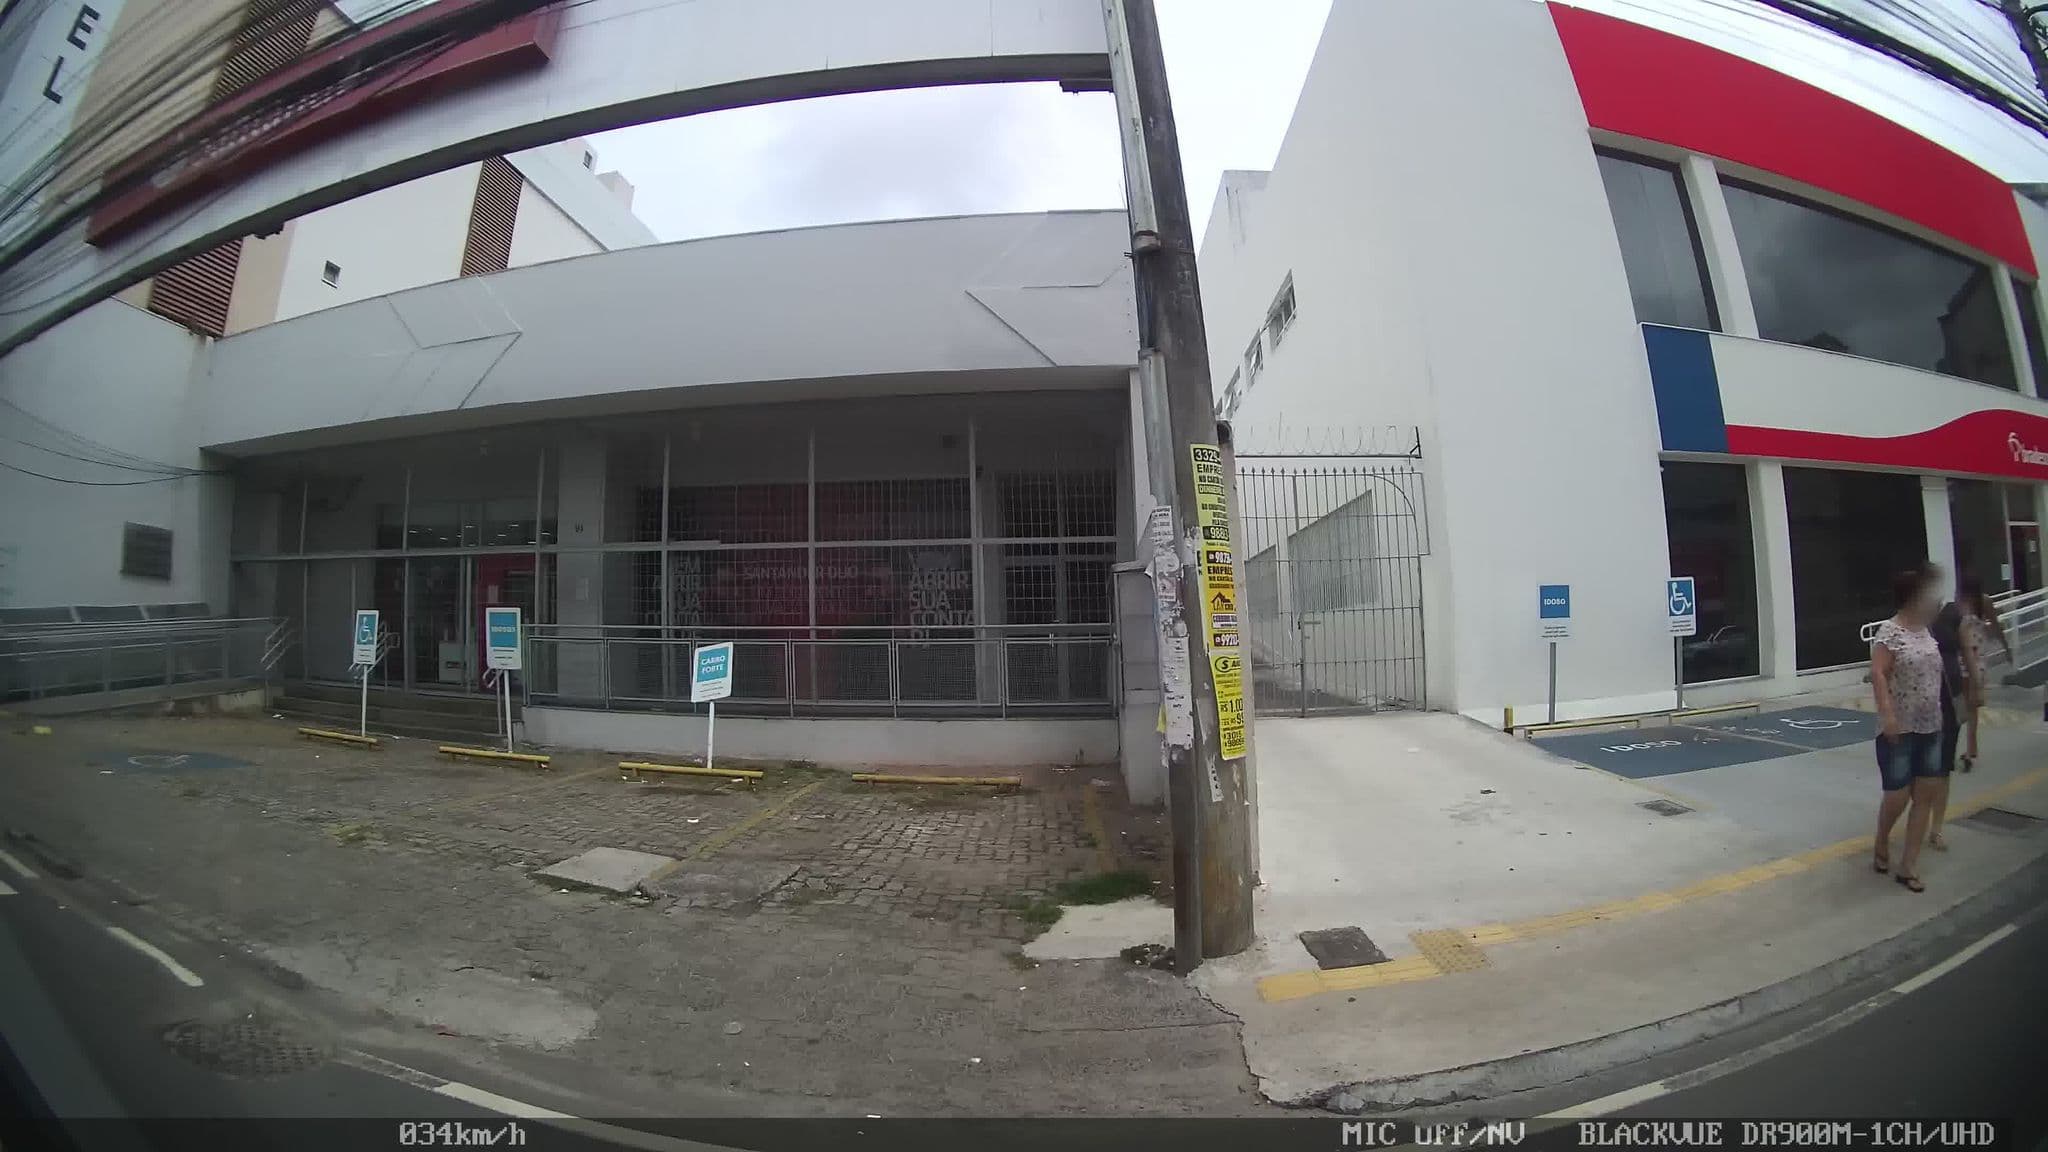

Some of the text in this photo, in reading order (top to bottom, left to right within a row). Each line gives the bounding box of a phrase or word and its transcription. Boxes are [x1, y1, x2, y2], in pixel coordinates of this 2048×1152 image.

[1544, 598, 1566, 606] IDOSO
[701, 655, 726, 665] CARRO
[702, 663, 724, 674] FORTE
[1600, 740, 1682, 753] IDOSO
